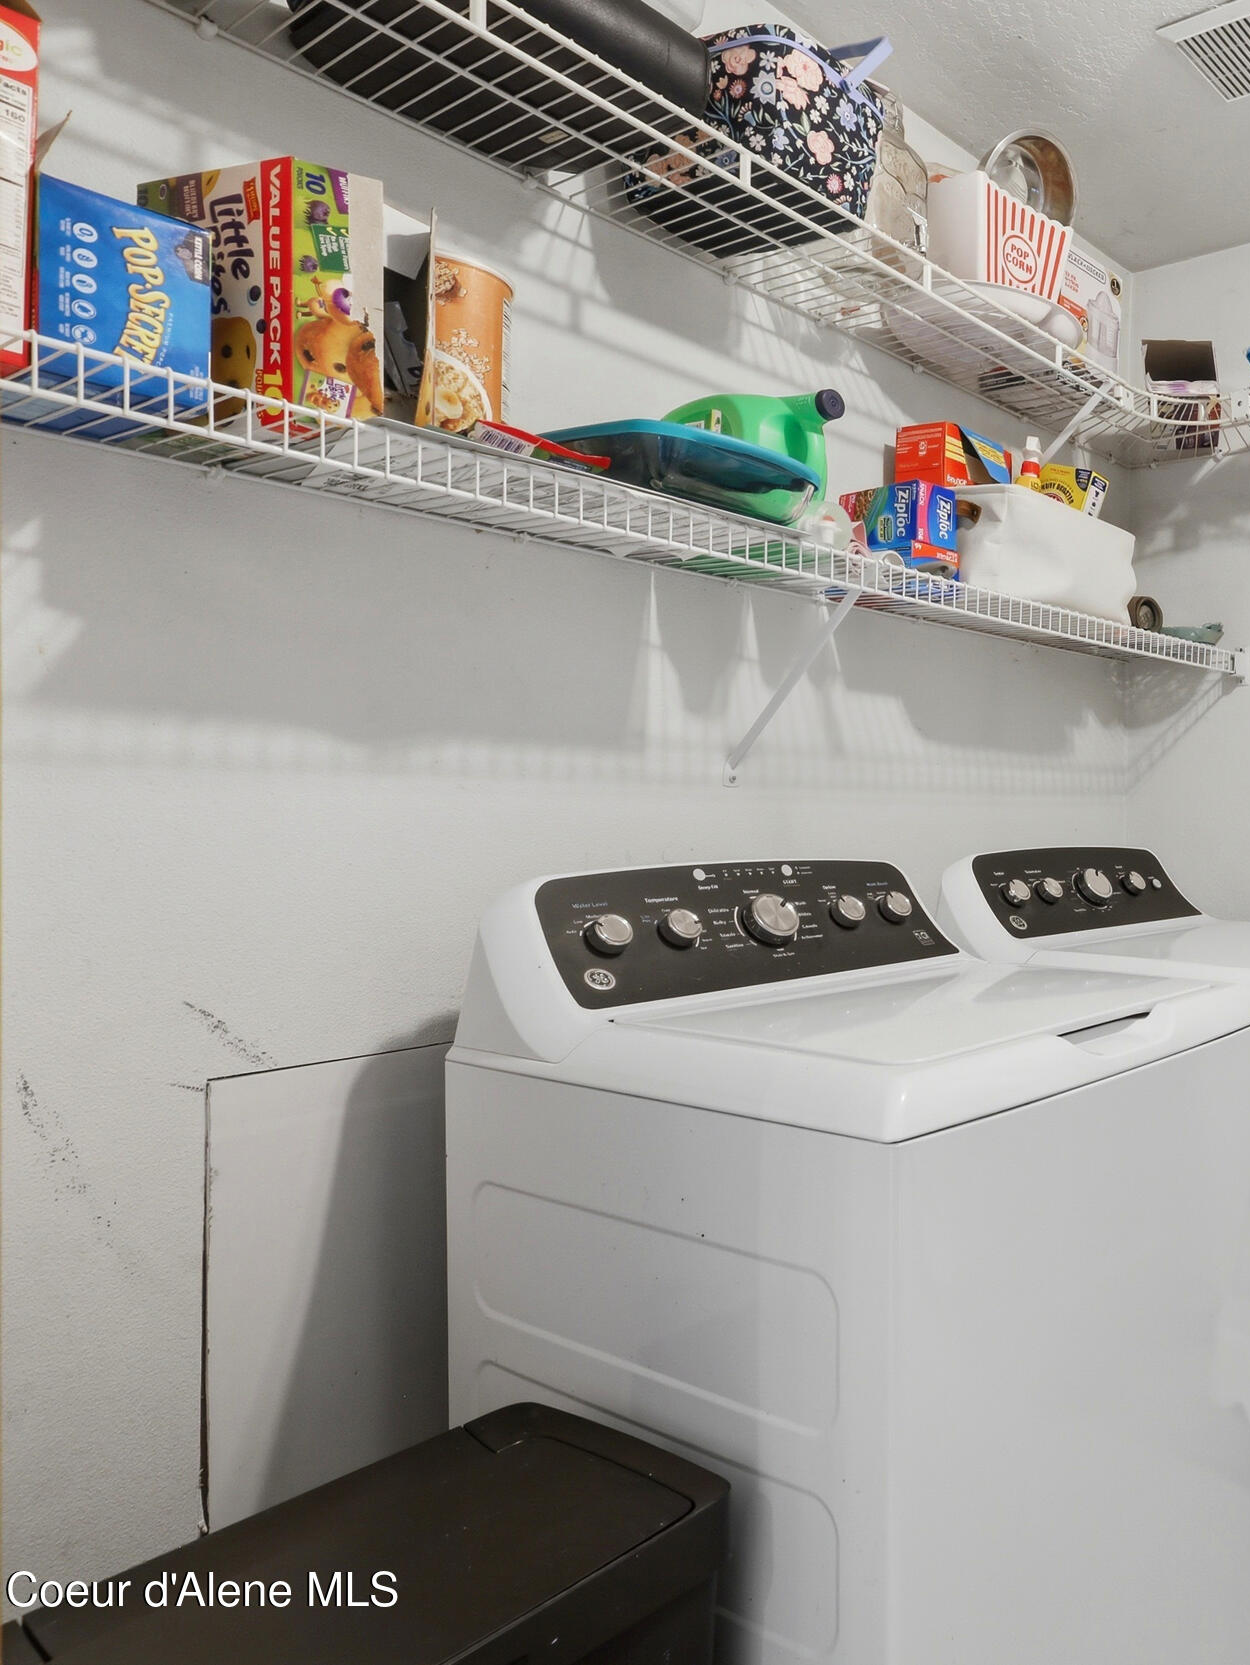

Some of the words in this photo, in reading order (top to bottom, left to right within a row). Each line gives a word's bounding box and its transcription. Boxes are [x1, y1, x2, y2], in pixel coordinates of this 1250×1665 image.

[305, 172, 326, 196] 10
[269, 164, 282, 270] VALUE
[193, 236, 203, 261] KETTLE
[209, 193, 255, 280] Little
[1010, 243, 1029, 260] POP
[194, 259, 204, 281] CORN
[1005, 252, 1032, 275] CORN
[269, 276, 282, 365] PACK
[894, 489, 909, 537] Ziploc
[936, 498, 951, 540] Ziploc
